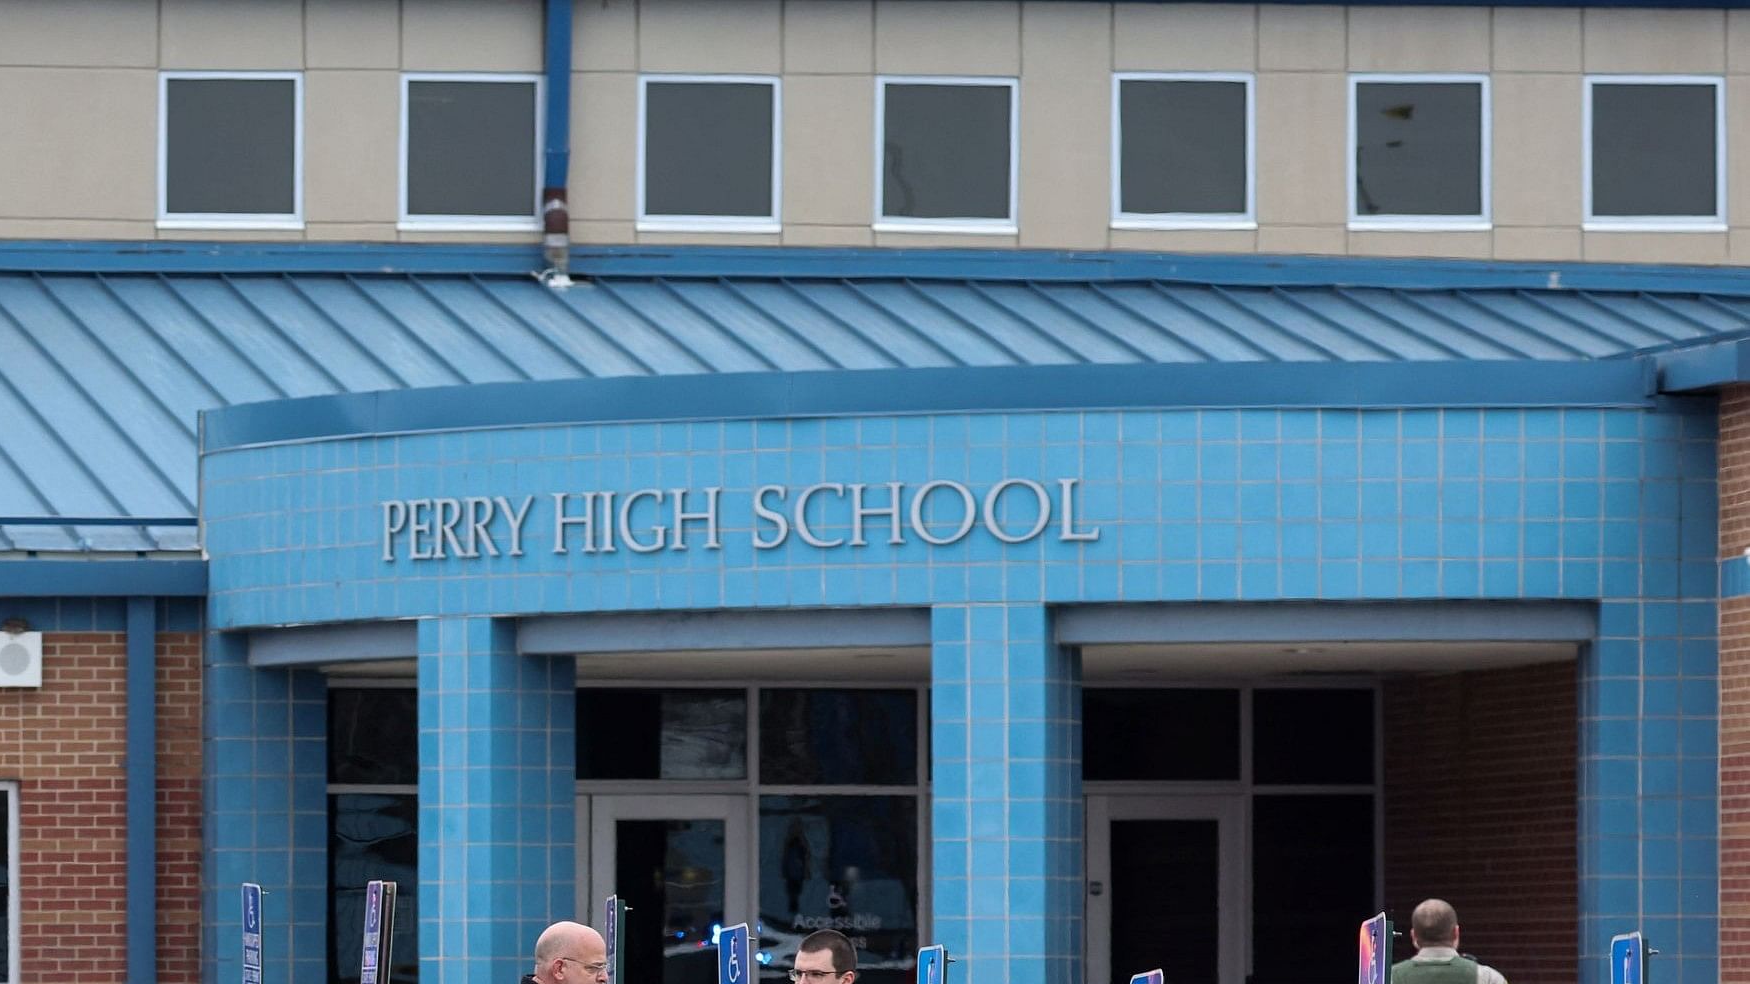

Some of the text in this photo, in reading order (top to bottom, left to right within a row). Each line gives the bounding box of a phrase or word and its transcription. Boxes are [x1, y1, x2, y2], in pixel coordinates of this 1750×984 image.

[382, 478, 1101, 562] PERRY HIGH SCHOOL
